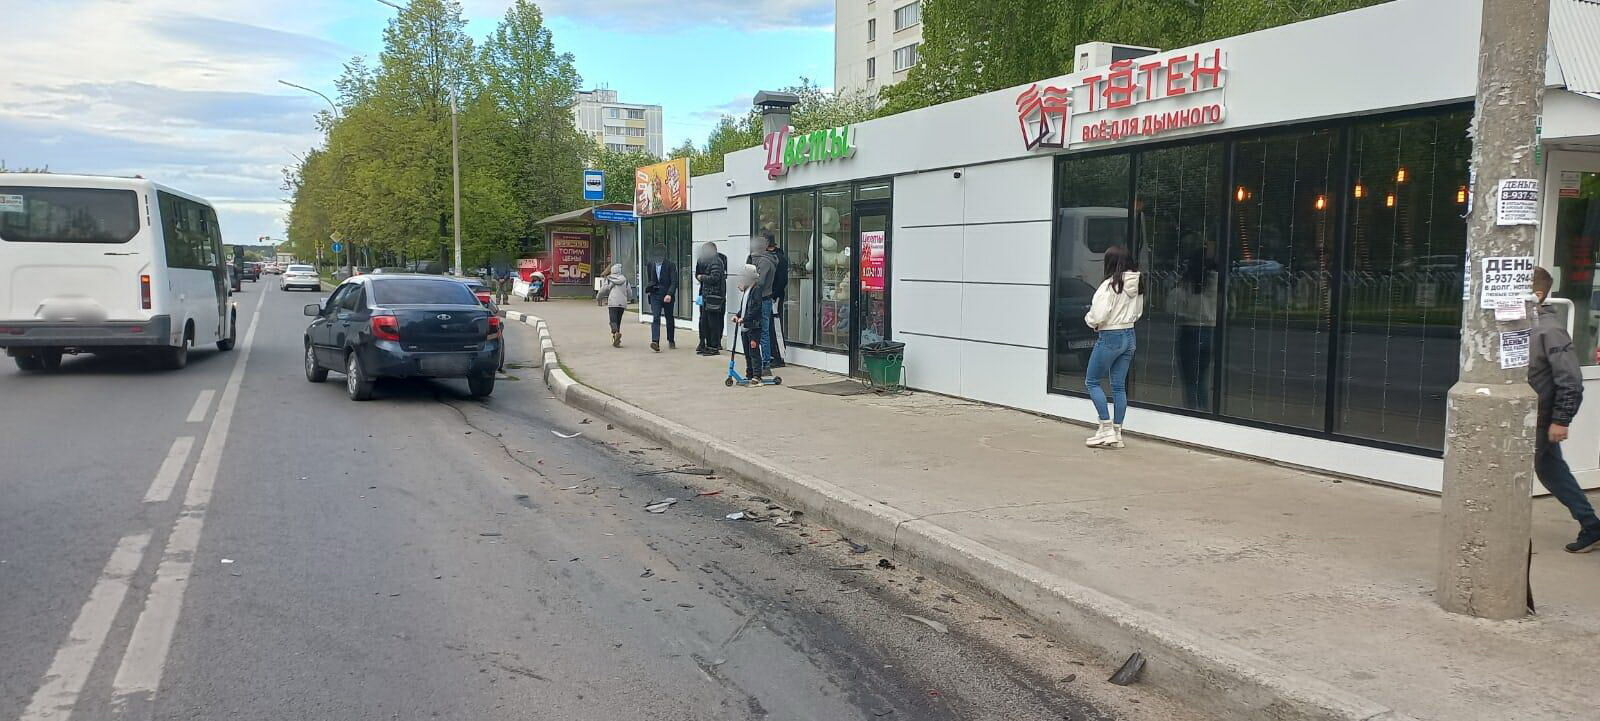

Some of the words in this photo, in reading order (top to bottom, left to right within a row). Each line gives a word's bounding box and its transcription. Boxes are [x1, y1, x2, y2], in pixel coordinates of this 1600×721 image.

[1082, 120, 1106, 142] ВСЁ
[1107, 119, 1139, 140] ДЛЯ
[1142, 104, 1222, 136] ДЫМНОГО
[1485, 259, 1534, 273] ДЕНЬ
